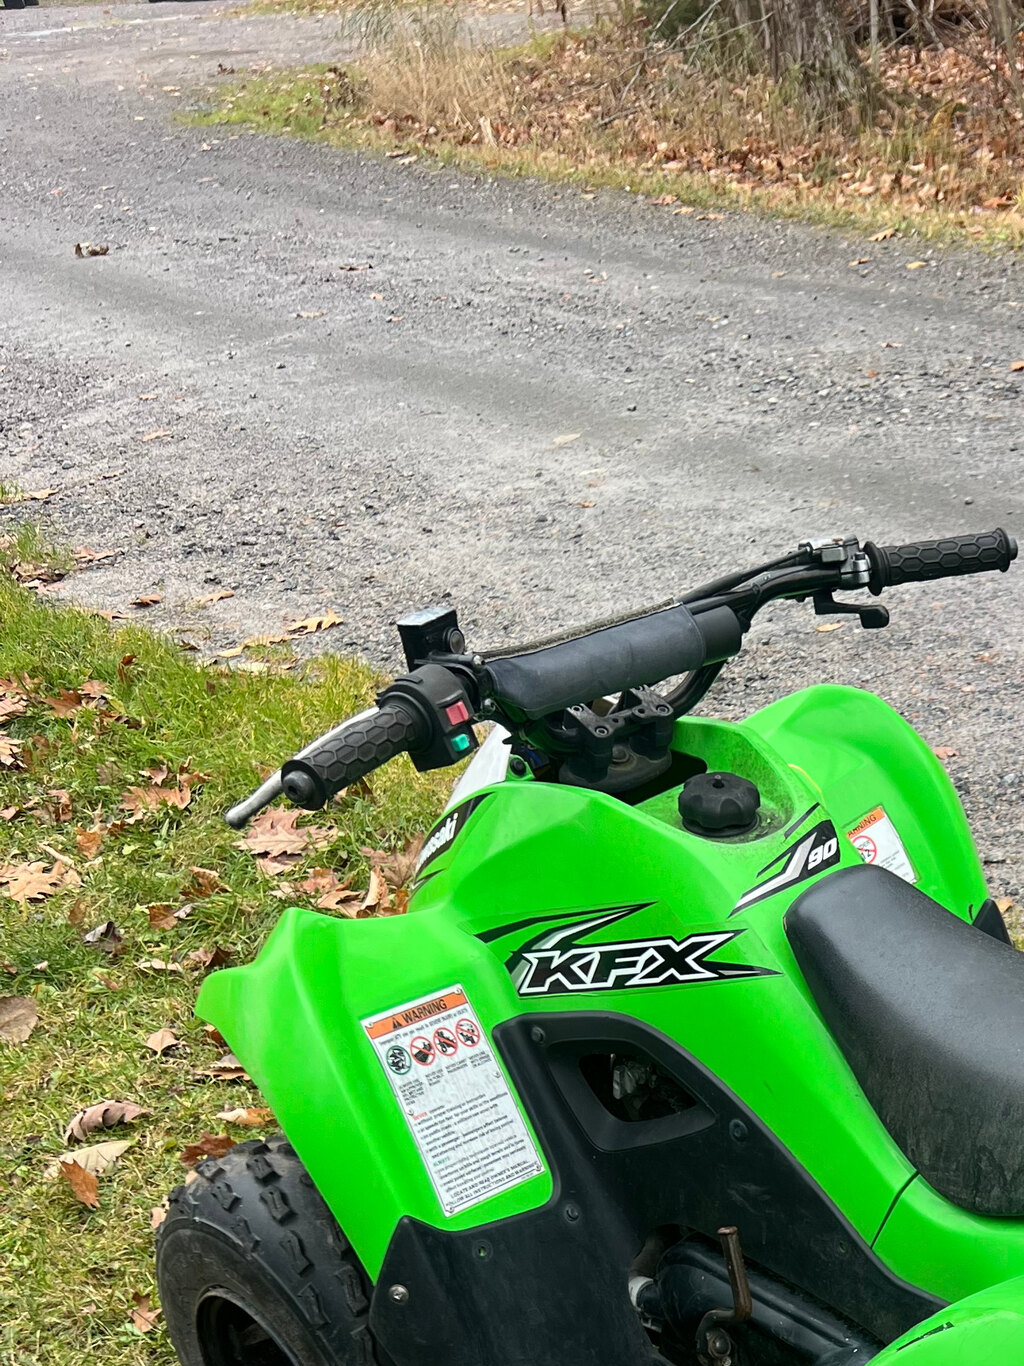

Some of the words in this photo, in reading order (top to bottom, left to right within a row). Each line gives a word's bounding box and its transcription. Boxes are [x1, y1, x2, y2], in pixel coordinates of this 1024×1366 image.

[847, 813, 877, 836] ARNING
[807, 837, 838, 871] 90
[519, 932, 737, 994] KFX
[401, 999, 447, 1024] WARNING
